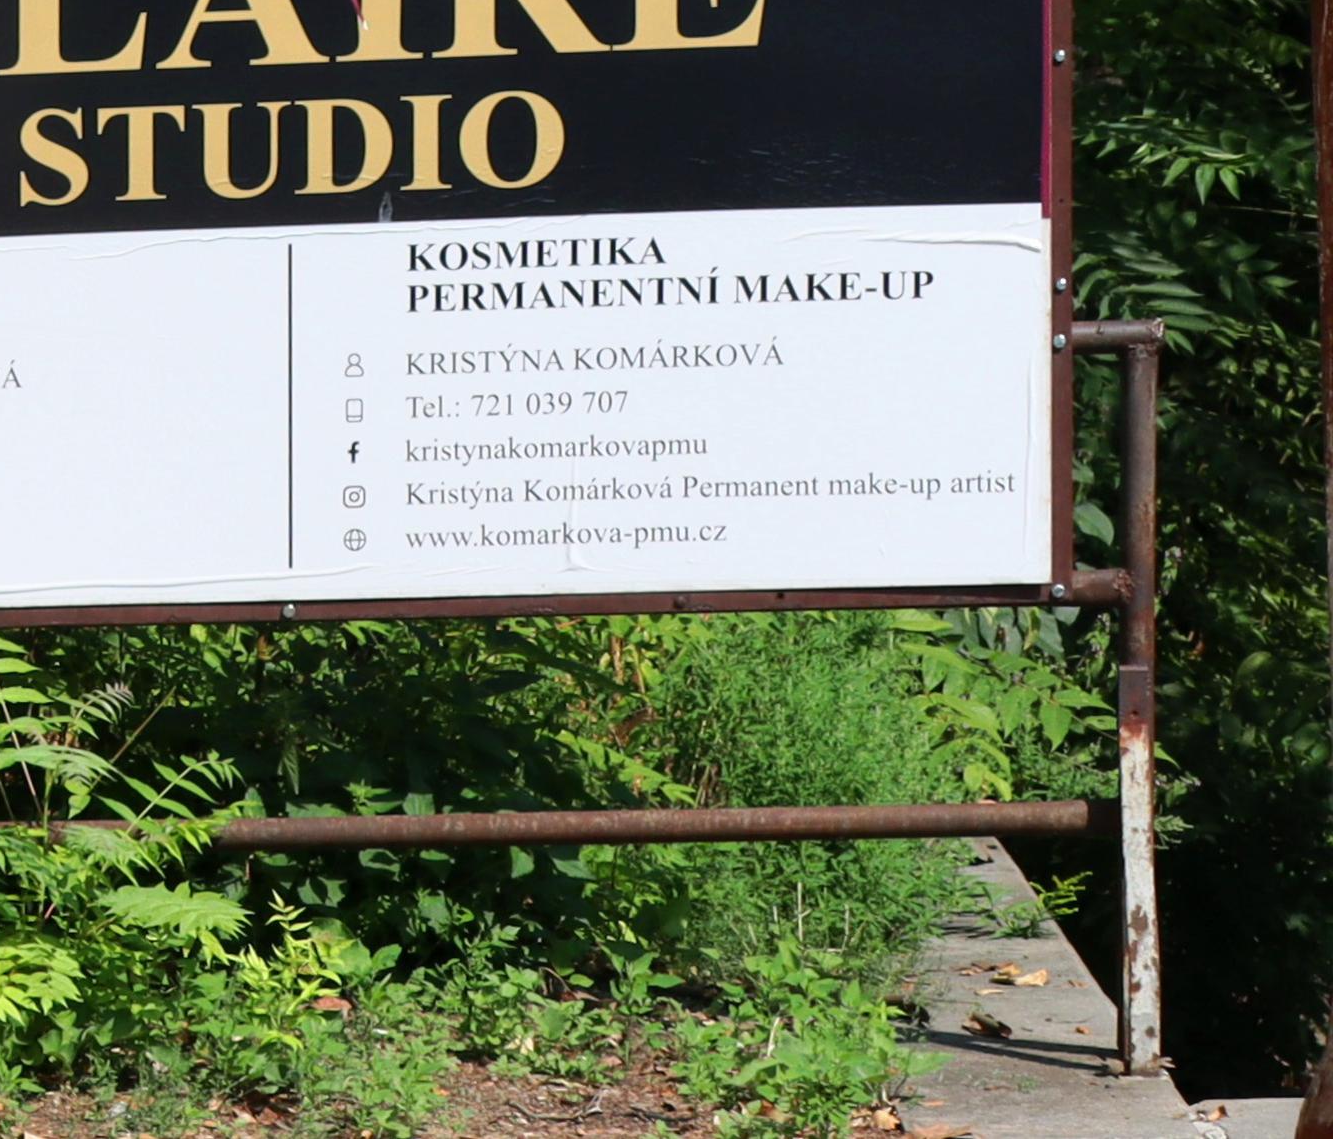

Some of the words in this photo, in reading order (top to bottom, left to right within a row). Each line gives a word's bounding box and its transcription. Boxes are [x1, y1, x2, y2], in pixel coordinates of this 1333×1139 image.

[20, 90, 565, 206] STUDIO
[407, 236, 667, 272] KOSMETIKA
[407, 266, 719, 313] PERMANENTNÍ
[733, 270, 934, 304] MAKE-UP
[406, 343, 565, 376] KRISTÝNA
[574, 335, 784, 371] KOMÁRKOVÁ
[405, 395, 460, 419] Tel.:
[471, 393, 512, 417] 721
[525, 391, 573, 415] 039
[582, 390, 628, 413] 707
[406, 434, 707, 467] kristynakomarkovapmu
[406, 480, 514, 510] Kristýna
[524, 476, 672, 502] Komárková
[683, 476, 818, 498] Permanent
[828, 471, 941, 501] make-up
[950, 469, 1014, 494] artist
[405, 521, 727, 550] www.komarkova-pmu.cz
